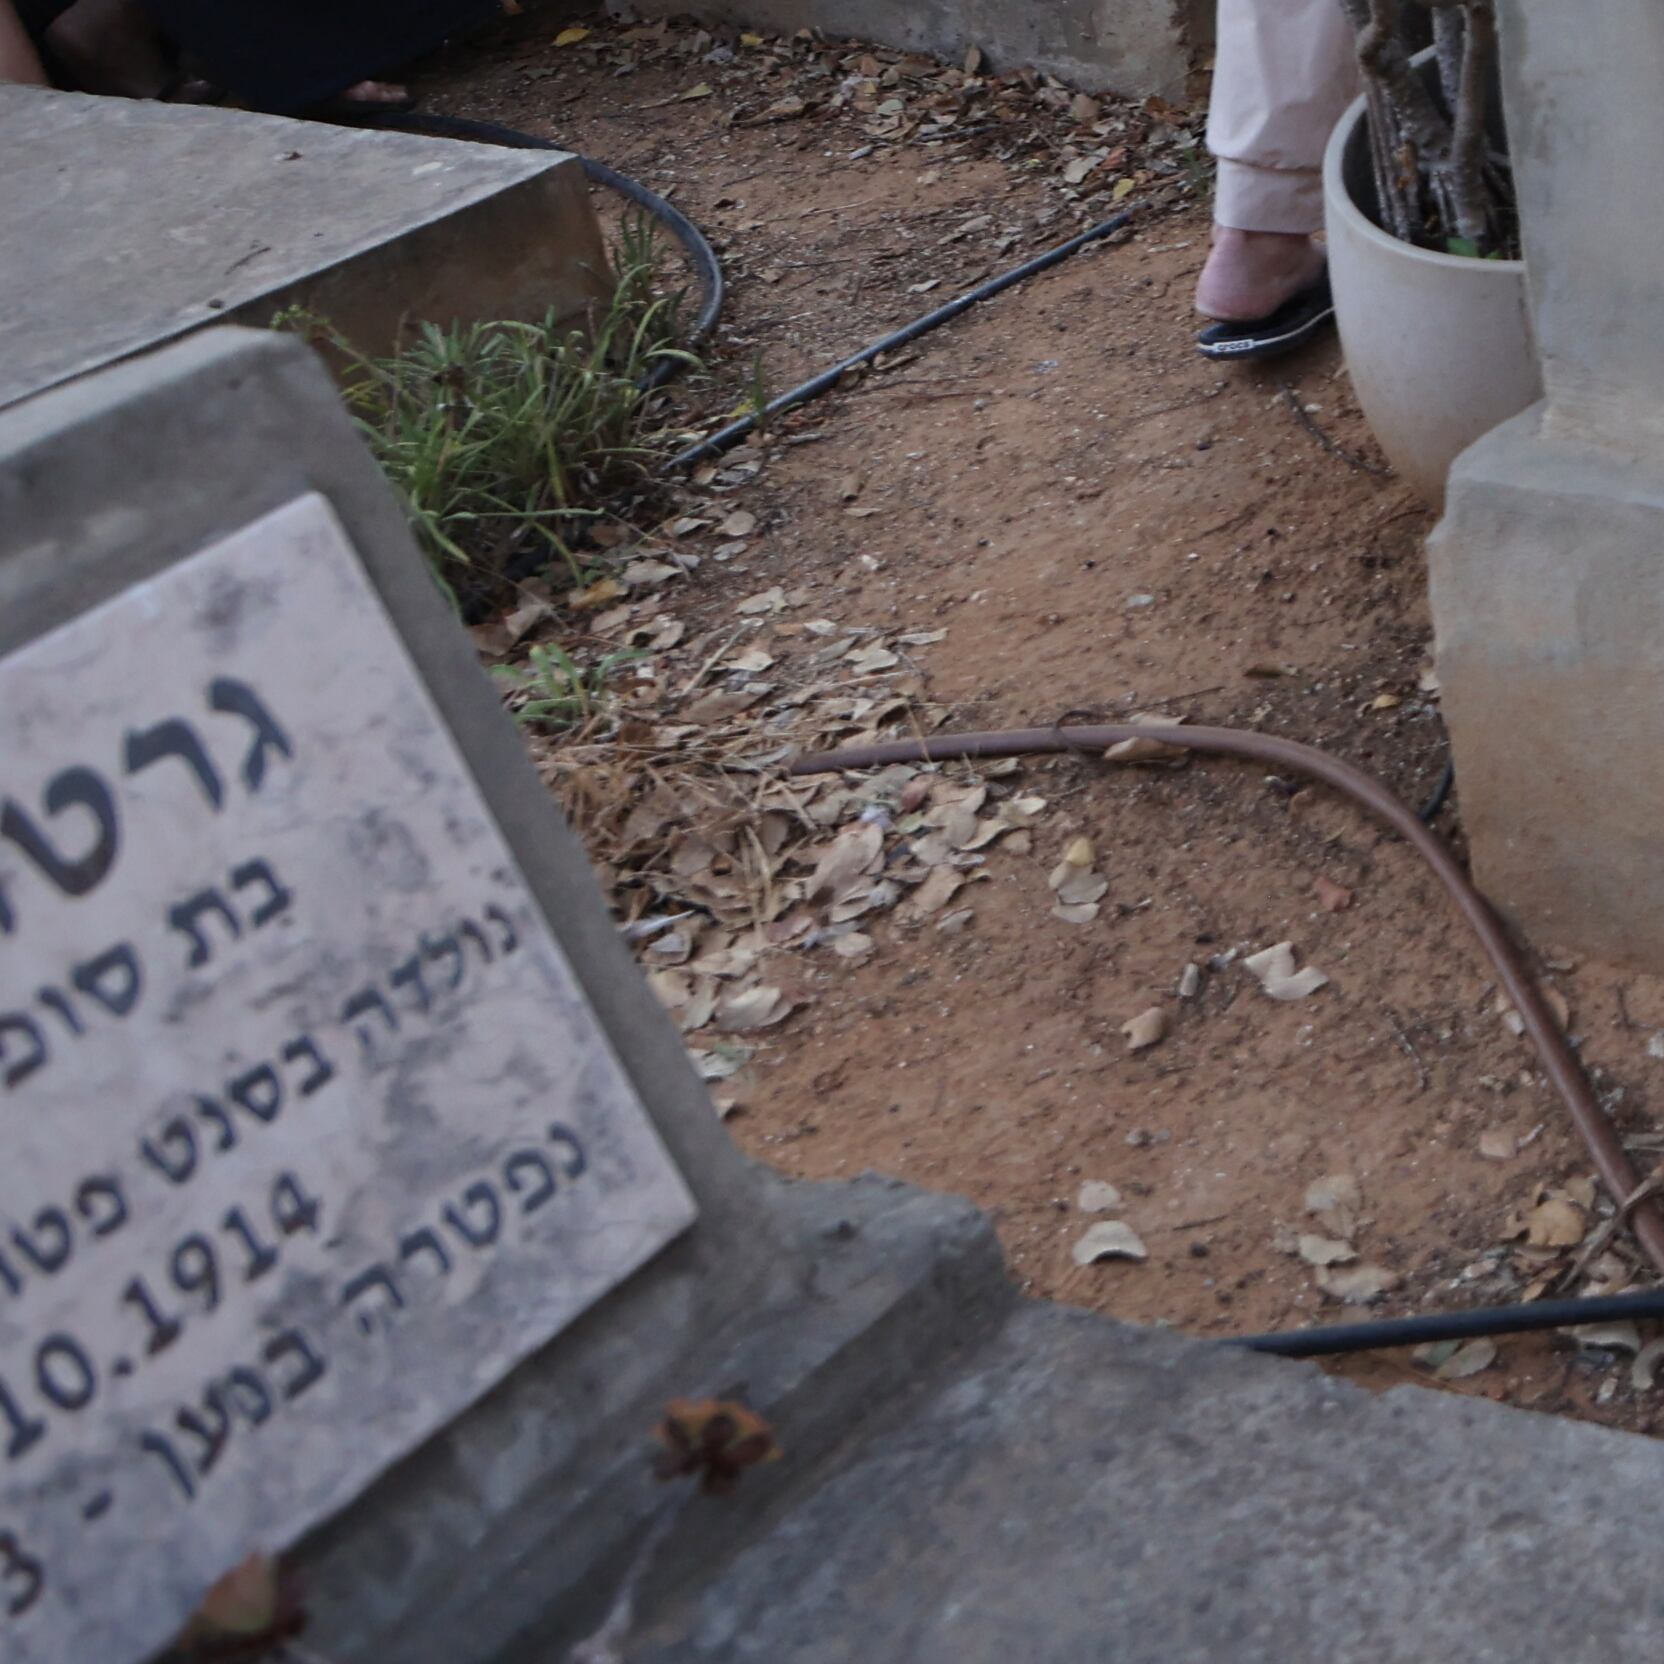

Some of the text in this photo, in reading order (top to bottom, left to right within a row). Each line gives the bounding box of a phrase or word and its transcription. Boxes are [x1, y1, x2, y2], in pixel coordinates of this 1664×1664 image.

[165, 856, 292, 971] בת
[341, 904, 521, 1050] נולדה
[140, 1034, 336, 1186] בסנט
[339, 1121, 589, 1336] נפטרה
